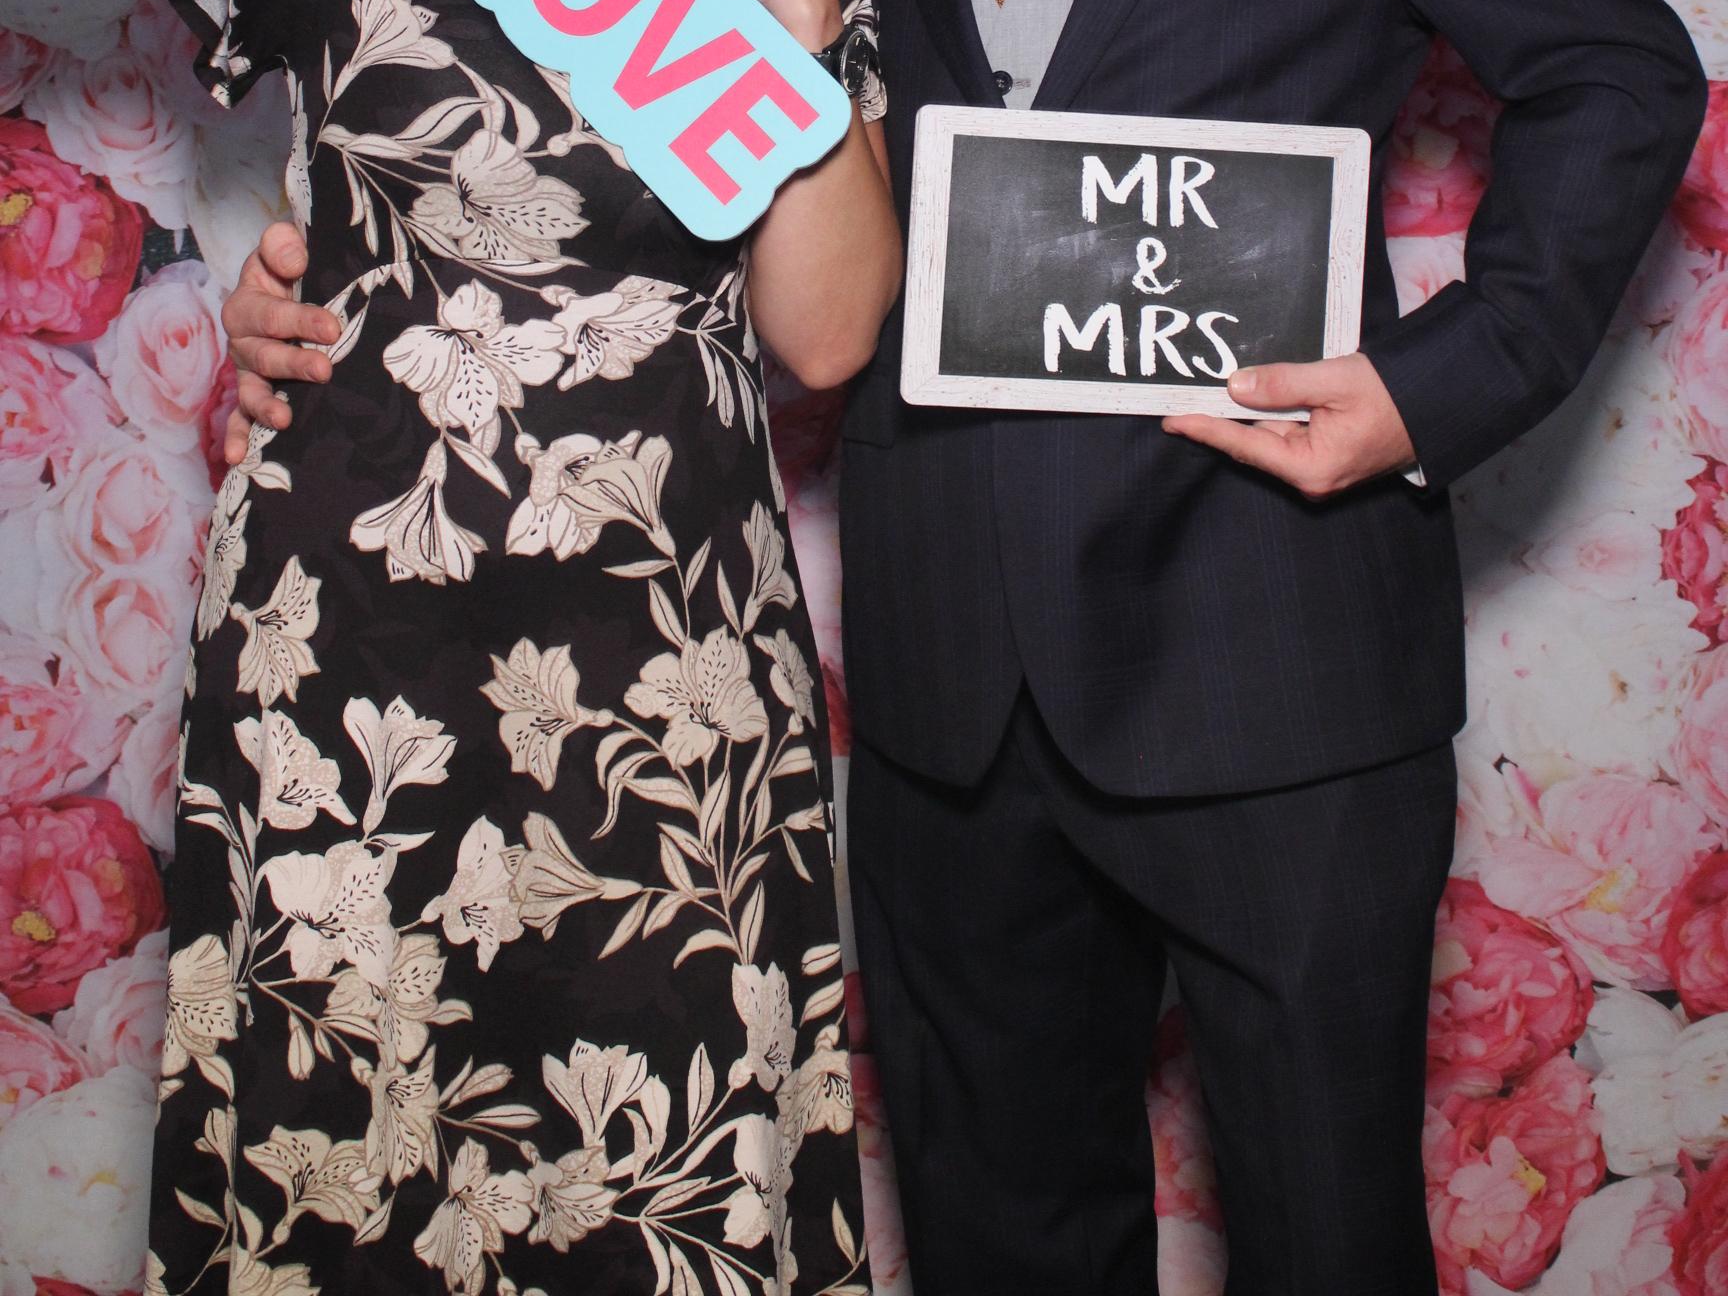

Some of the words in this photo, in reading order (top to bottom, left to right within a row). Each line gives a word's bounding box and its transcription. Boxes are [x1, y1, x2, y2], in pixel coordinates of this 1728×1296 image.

[1081, 152, 1219, 229] MR
[1132, 237, 1182, 295] &
[1043, 302, 1240, 379] MRS
